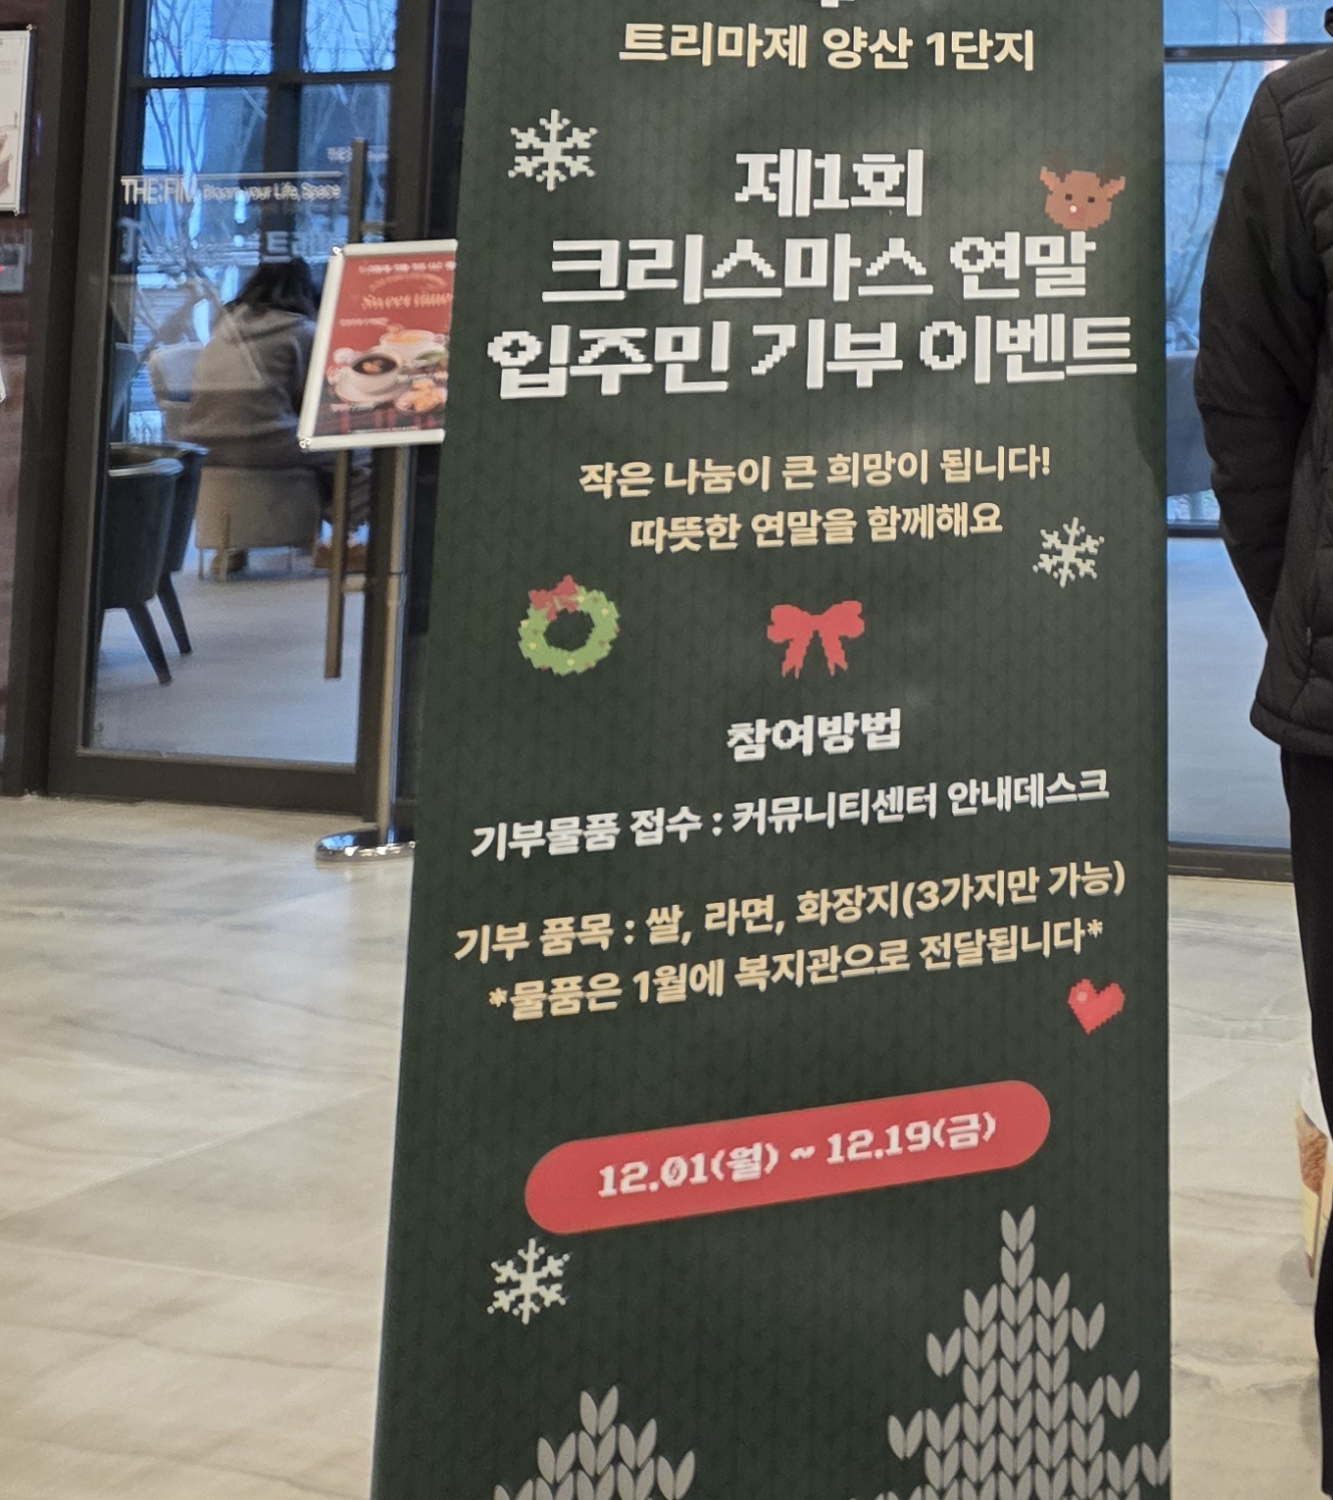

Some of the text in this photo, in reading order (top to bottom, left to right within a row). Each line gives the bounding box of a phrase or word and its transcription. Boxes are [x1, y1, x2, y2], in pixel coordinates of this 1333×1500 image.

[618, 21, 1036, 73] 트리마제 양산 1단지
[734, 148, 923, 219] 제1회
[541, 231, 1096, 304] 크리스마스 연말
[486, 312, 1138, 400] 입주민 기부 이벤트
[578, 444, 1052, 499] 작은 나눔이 큰 희망이 됩니다!
[629, 501, 1003, 554] 따뜻한 연말을 함께해요
[726, 707, 903, 762] 참여방법
[471, 769, 1110, 862] 기부물품 접수 : 커뮤니티센터 안내데스크
[453, 859, 1127, 966] 기부 품목 : 쌀, 라면, 화장지(3가지만 가능)
[633, 960, 725, 1006] 1월에
[733, 941, 911, 993] 복지관으로
[598, 1142, 779, 1198] 12.01(월)
[825, 1111, 998, 1168] 12.19(금)
